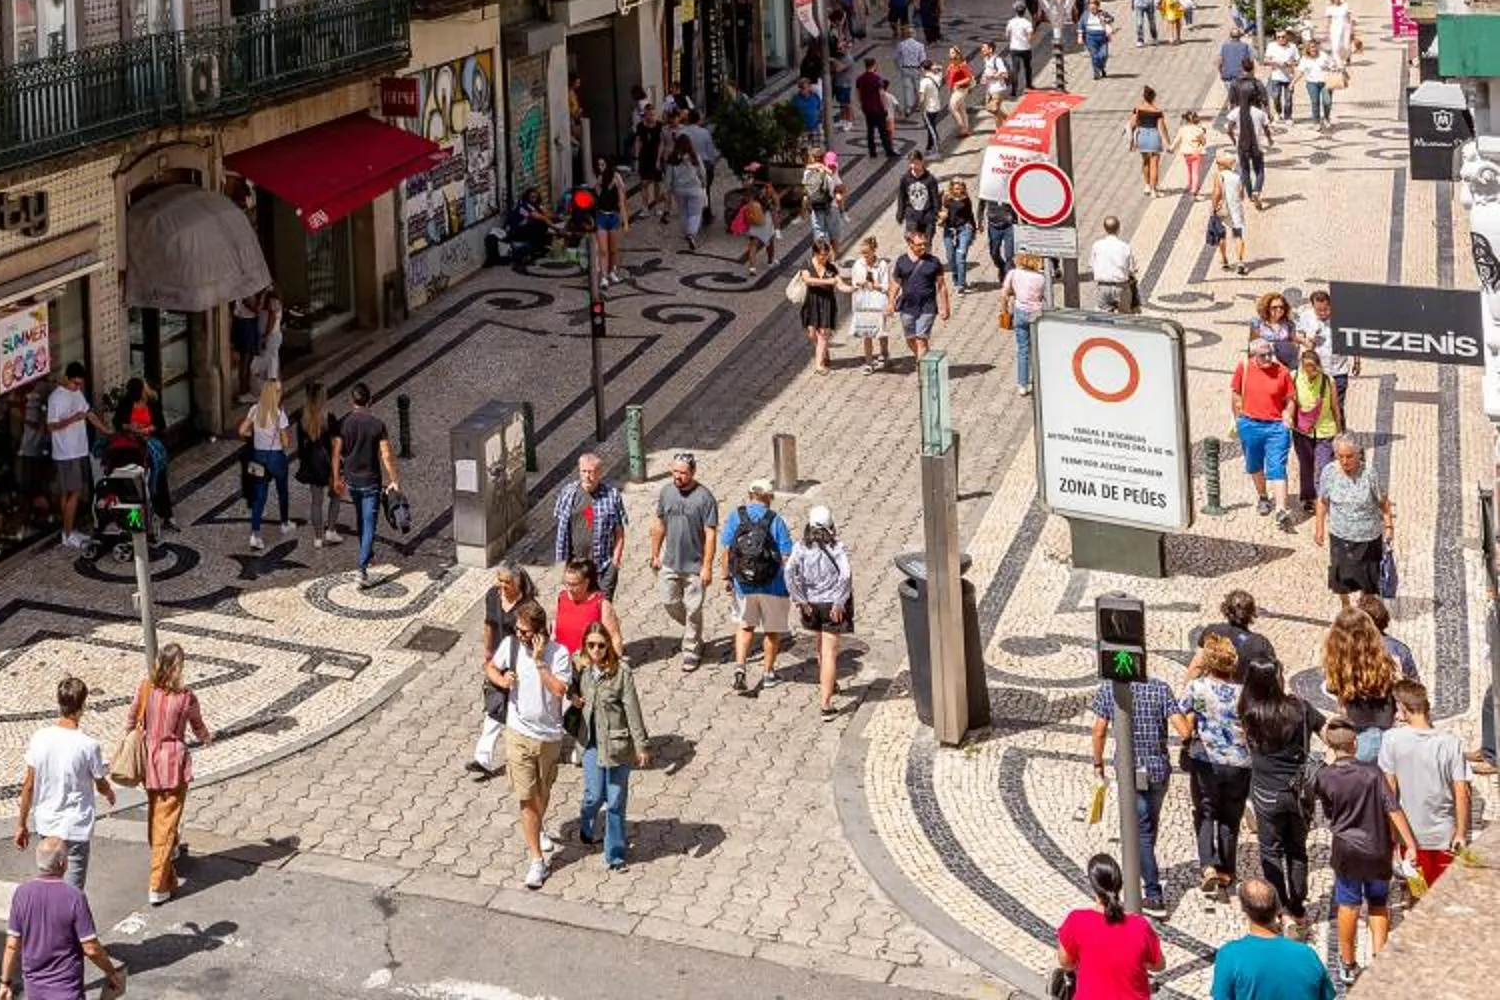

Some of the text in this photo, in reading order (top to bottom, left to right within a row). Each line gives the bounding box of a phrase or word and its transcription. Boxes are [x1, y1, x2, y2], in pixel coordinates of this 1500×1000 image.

[1059, 478, 1168, 509] ZONA DE PEÕES
